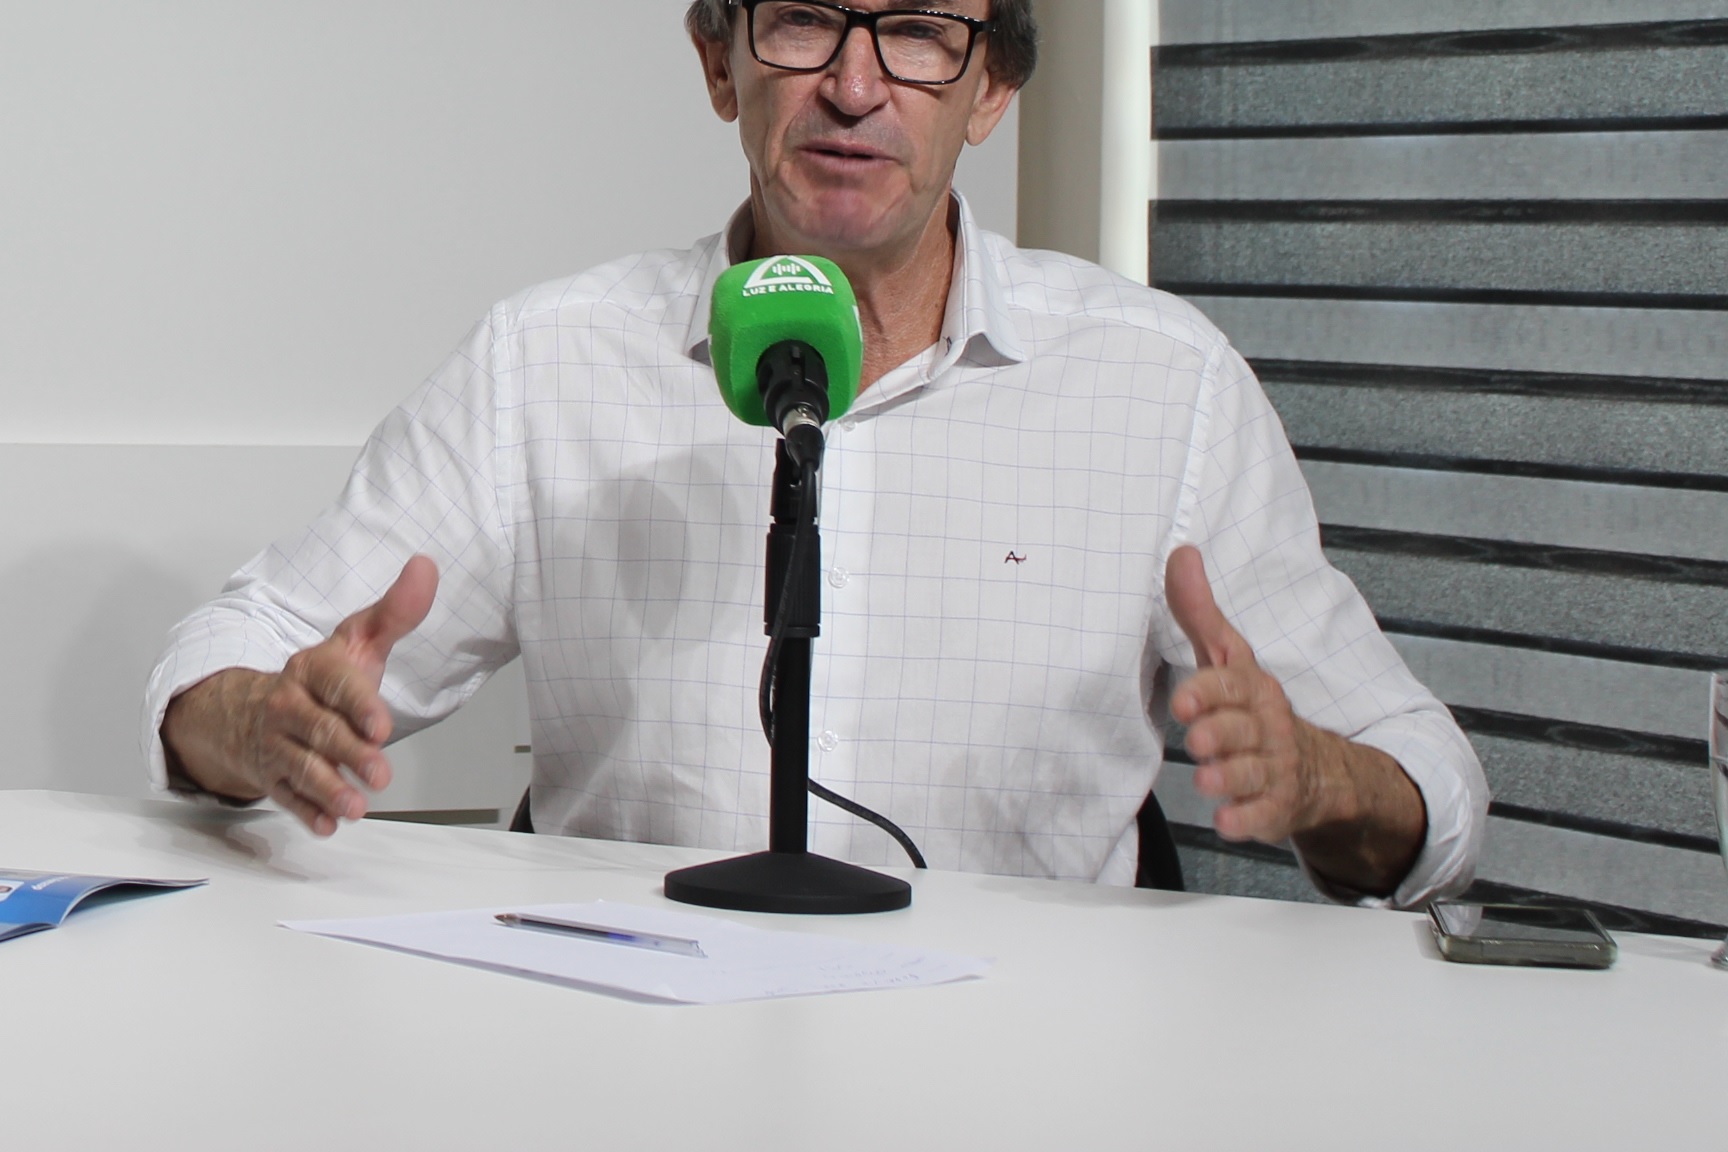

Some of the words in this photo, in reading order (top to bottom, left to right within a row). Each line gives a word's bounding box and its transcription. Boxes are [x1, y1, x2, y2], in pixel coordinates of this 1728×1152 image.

[742, 286, 767, 297] LUZ
[768, 285, 777, 293] E
[778, 283, 834, 295] ALEGRIA
